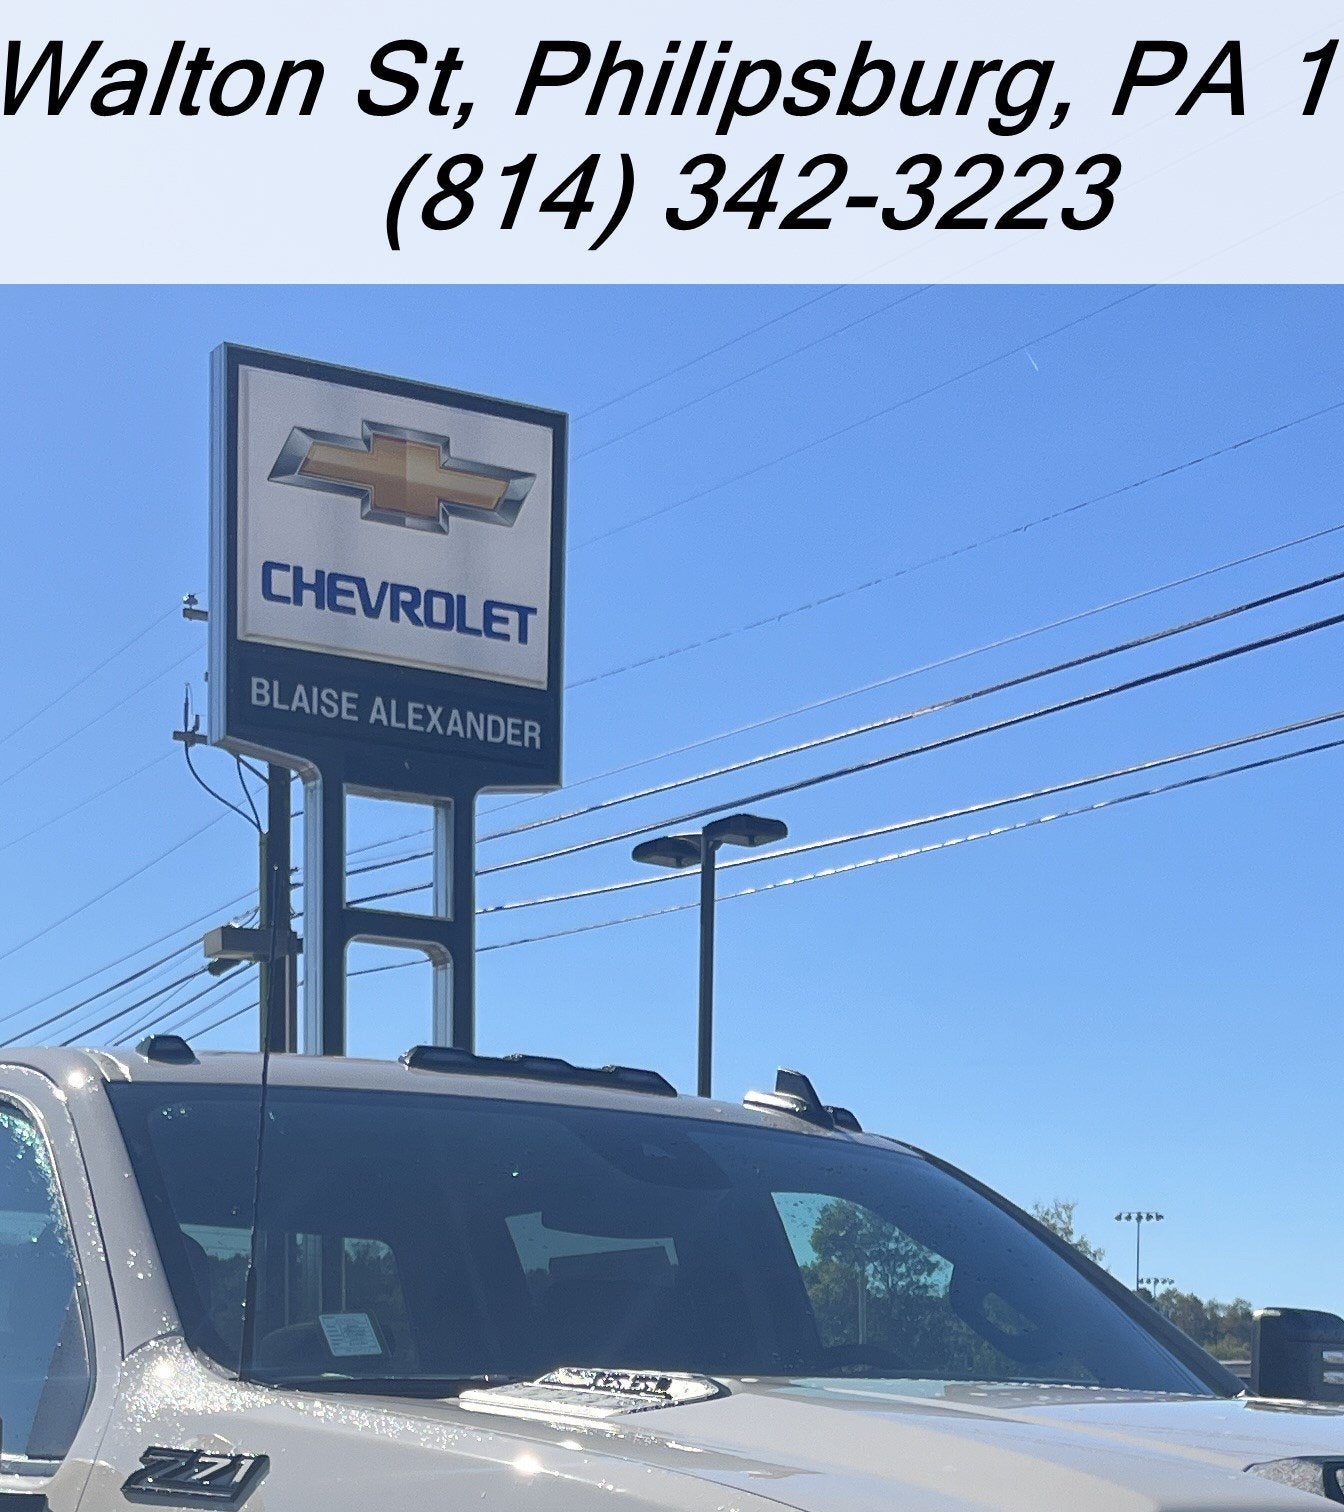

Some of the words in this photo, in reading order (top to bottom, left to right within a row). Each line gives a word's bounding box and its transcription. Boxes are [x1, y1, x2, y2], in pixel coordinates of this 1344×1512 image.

[262, 560, 537, 645] CHEVROLET
[250, 676, 359, 722] BLAISE
[369, 696, 542, 750] ALEXANDER
[120, 1445, 270, 1512] Z71
